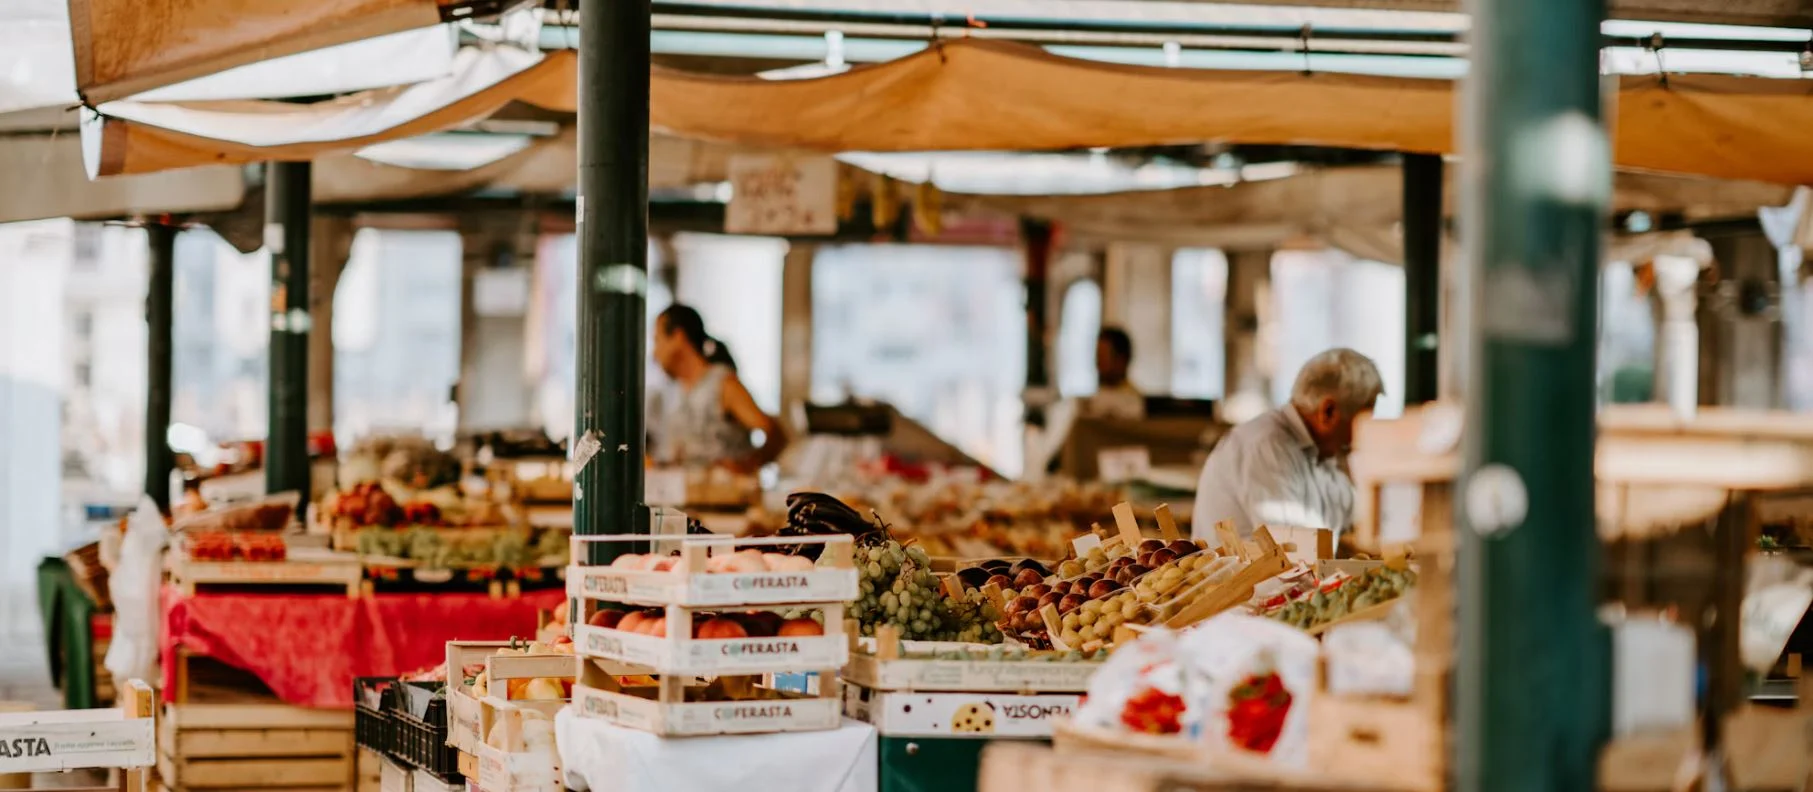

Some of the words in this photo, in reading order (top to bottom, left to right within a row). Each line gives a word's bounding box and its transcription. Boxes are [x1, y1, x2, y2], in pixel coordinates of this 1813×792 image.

[733, 576, 808, 590] COFERASTA
[721, 642, 798, 655] COFERASTA
[714, 705, 792, 720] COFERASTA
[0, 737, 51, 758] ASTA
